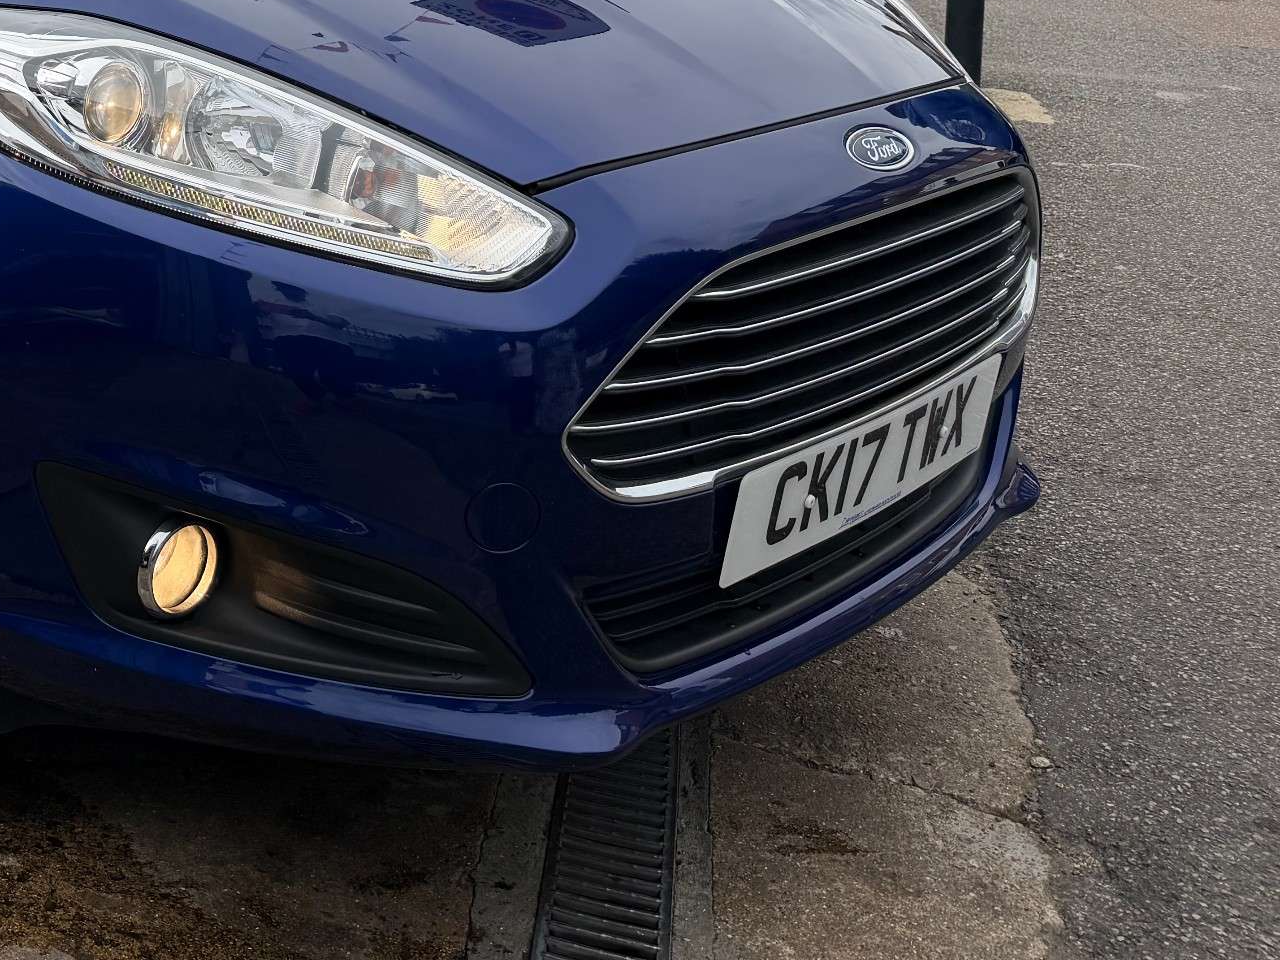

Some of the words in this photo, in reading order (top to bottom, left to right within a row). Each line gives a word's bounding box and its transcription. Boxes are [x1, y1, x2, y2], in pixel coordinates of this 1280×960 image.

[861, 135, 902, 162] Ford
[766, 423, 891, 546] CK17
[897, 375, 978, 483] TWX
